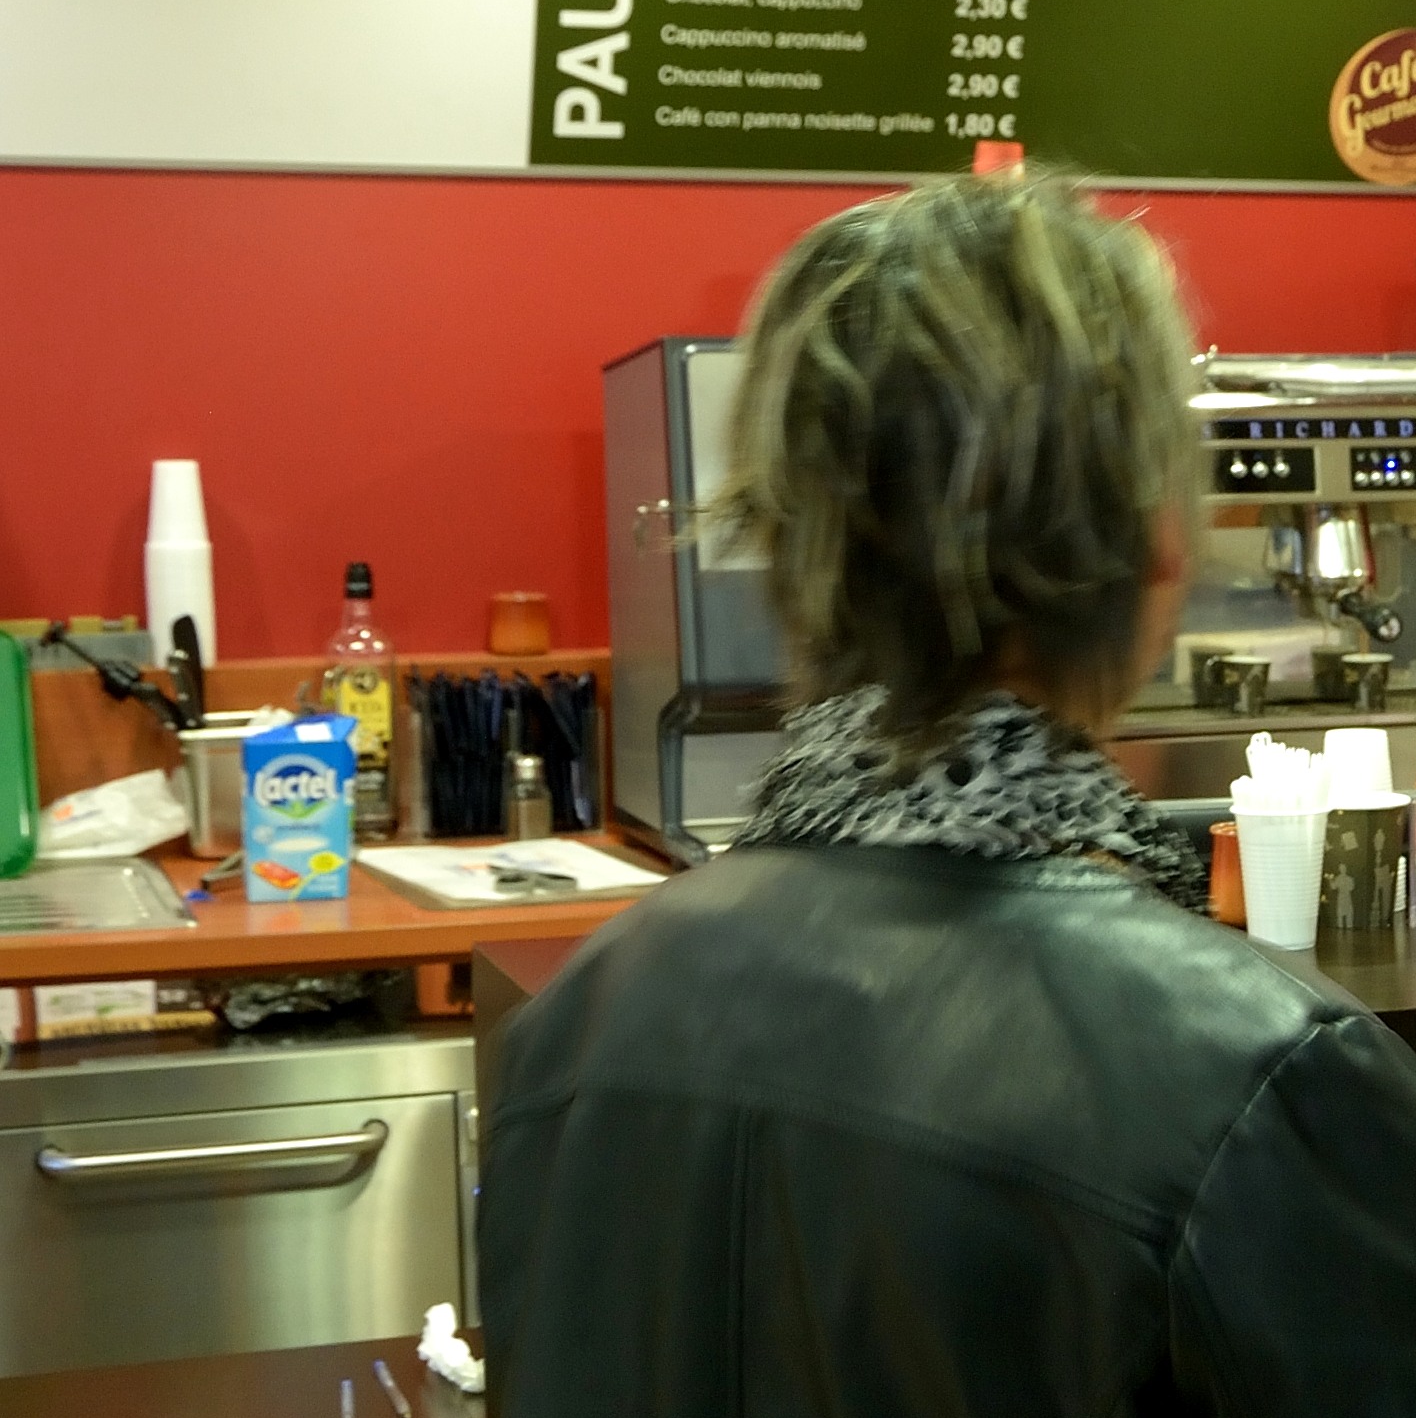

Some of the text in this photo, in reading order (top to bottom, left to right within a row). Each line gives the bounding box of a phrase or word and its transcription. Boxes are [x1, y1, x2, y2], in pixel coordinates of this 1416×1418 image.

[950, 33, 1024, 60] 2,90 €
[947, 73, 1020, 99] 2,90 €
[945, 113, 1016, 138] 1,80 €
[1249, 420, 1415, 439] RICHARD
